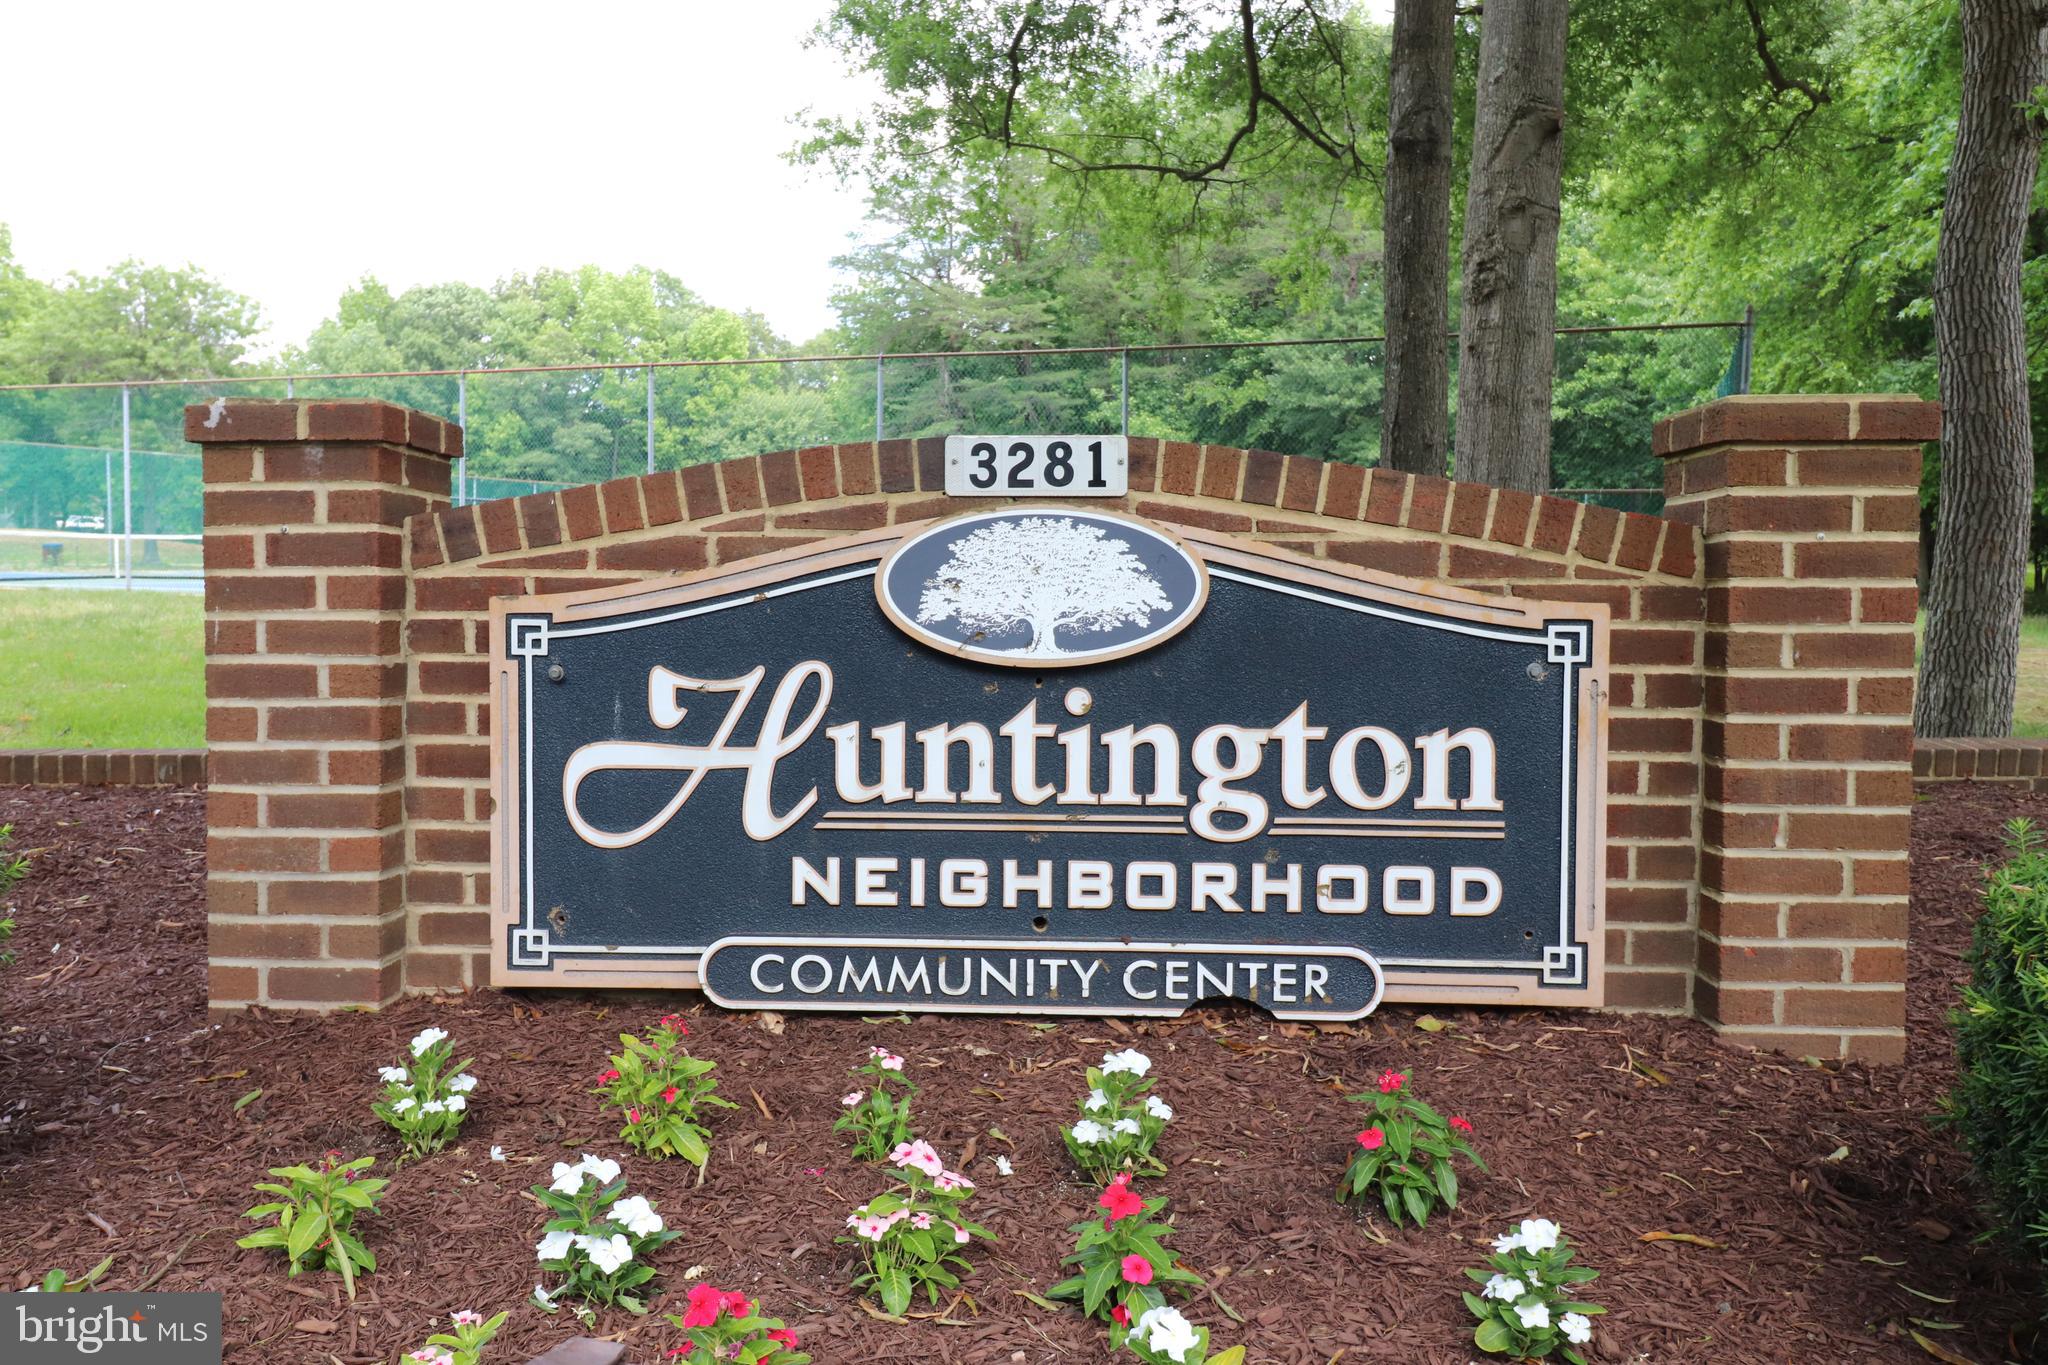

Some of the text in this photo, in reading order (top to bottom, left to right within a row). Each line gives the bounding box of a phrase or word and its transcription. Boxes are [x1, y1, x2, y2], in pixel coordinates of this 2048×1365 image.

[969, 441, 1107, 488] 3281
[563, 660, 1505, 849] Huntington
[791, 856, 1503, 917] NEIGHBORHOOD
[749, 953, 1330, 1002] COMMUNITY CENTER
